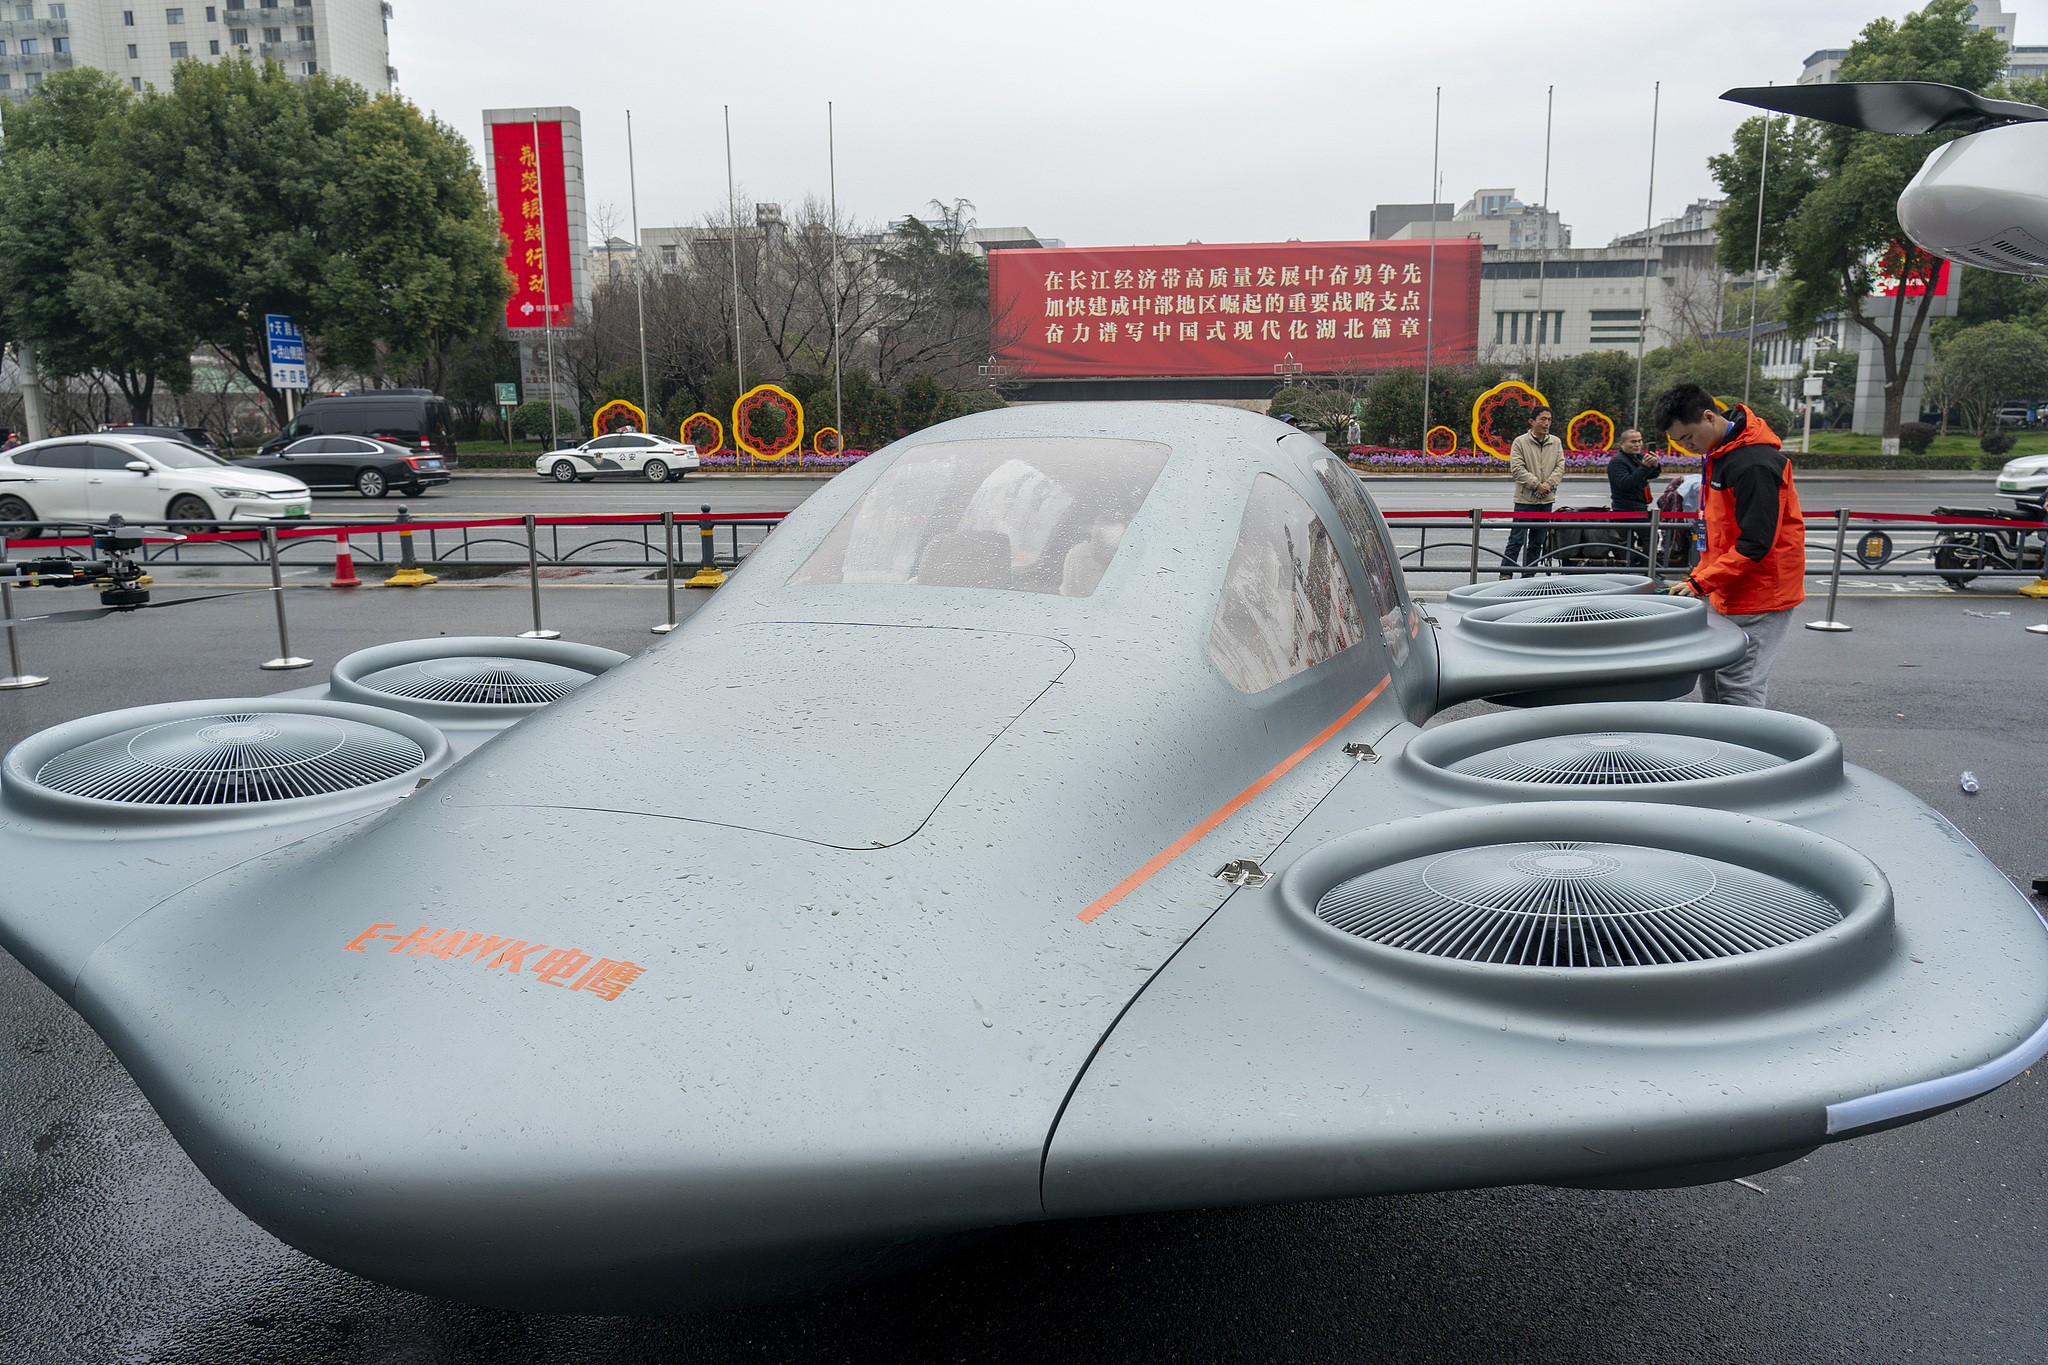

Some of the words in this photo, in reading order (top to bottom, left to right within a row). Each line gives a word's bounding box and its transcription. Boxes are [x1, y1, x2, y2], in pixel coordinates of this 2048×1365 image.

[519, 144, 545, 293] 荆楚银龄行动
[1044, 263, 1422, 291] 在长江经济带高质量发展中奋勇争先
[1044, 290, 1421, 318] 加快建成中部地区崛起的重要战略支点
[1045, 317, 1421, 344] 奋力谱写中国式现代化湖北篇章
[618, 453, 636, 462] 公安
